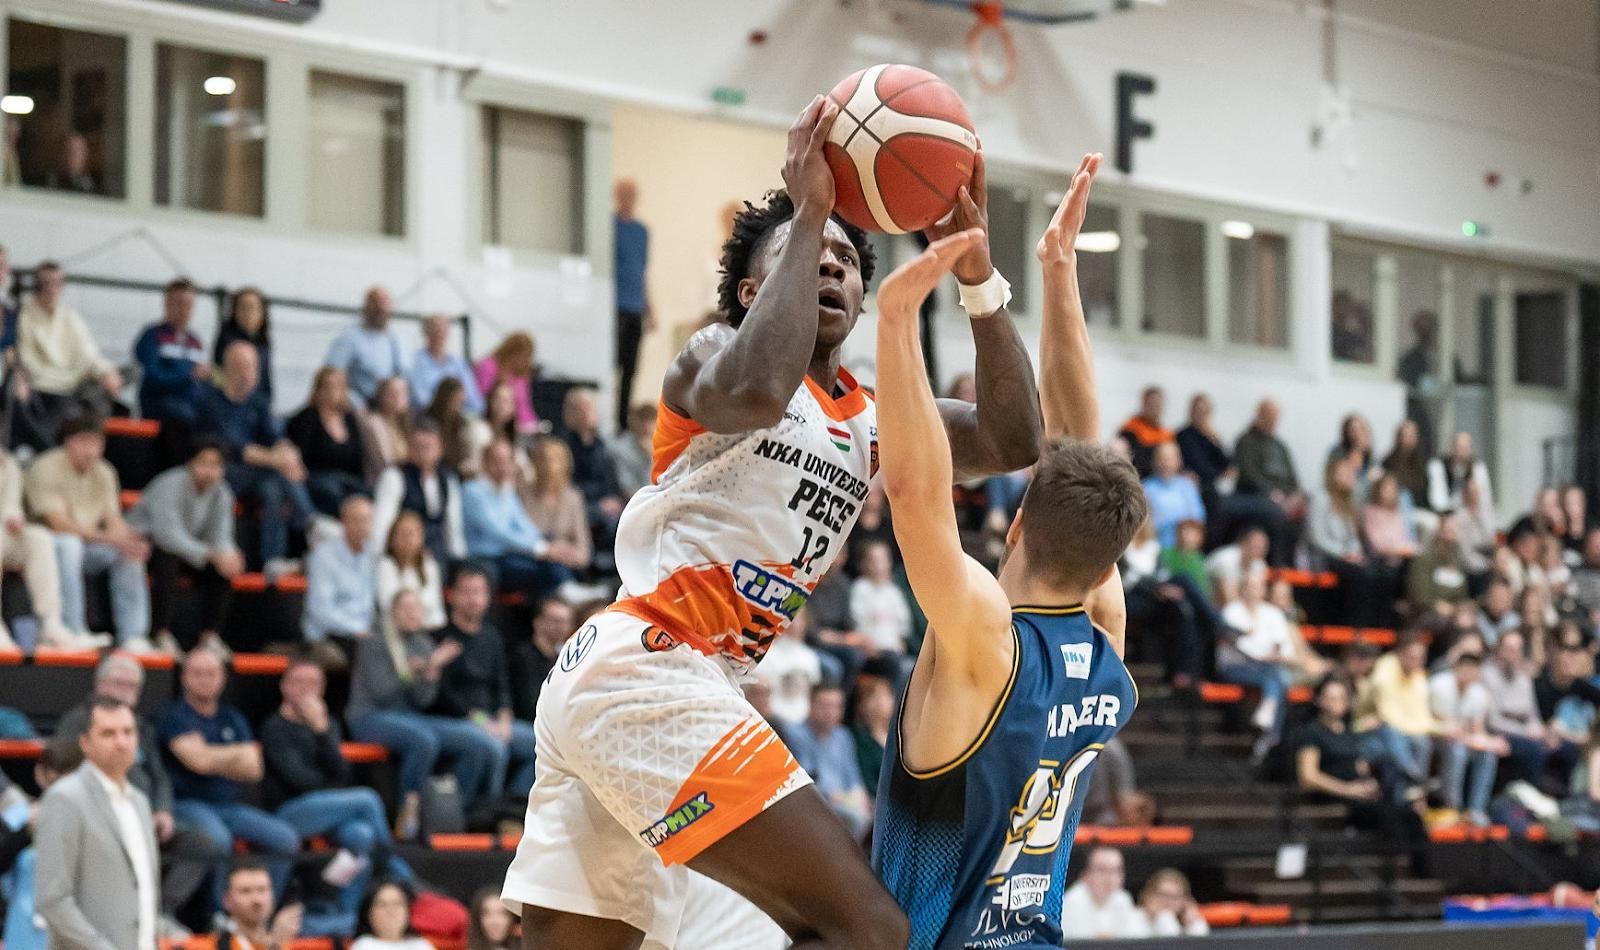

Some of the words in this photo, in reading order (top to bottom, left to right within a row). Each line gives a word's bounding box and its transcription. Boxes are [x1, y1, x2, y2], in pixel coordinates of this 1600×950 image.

[1115, 71, 1156, 173] F
[754, 439, 802, 467] NKA
[791, 526, 830, 575] 12
